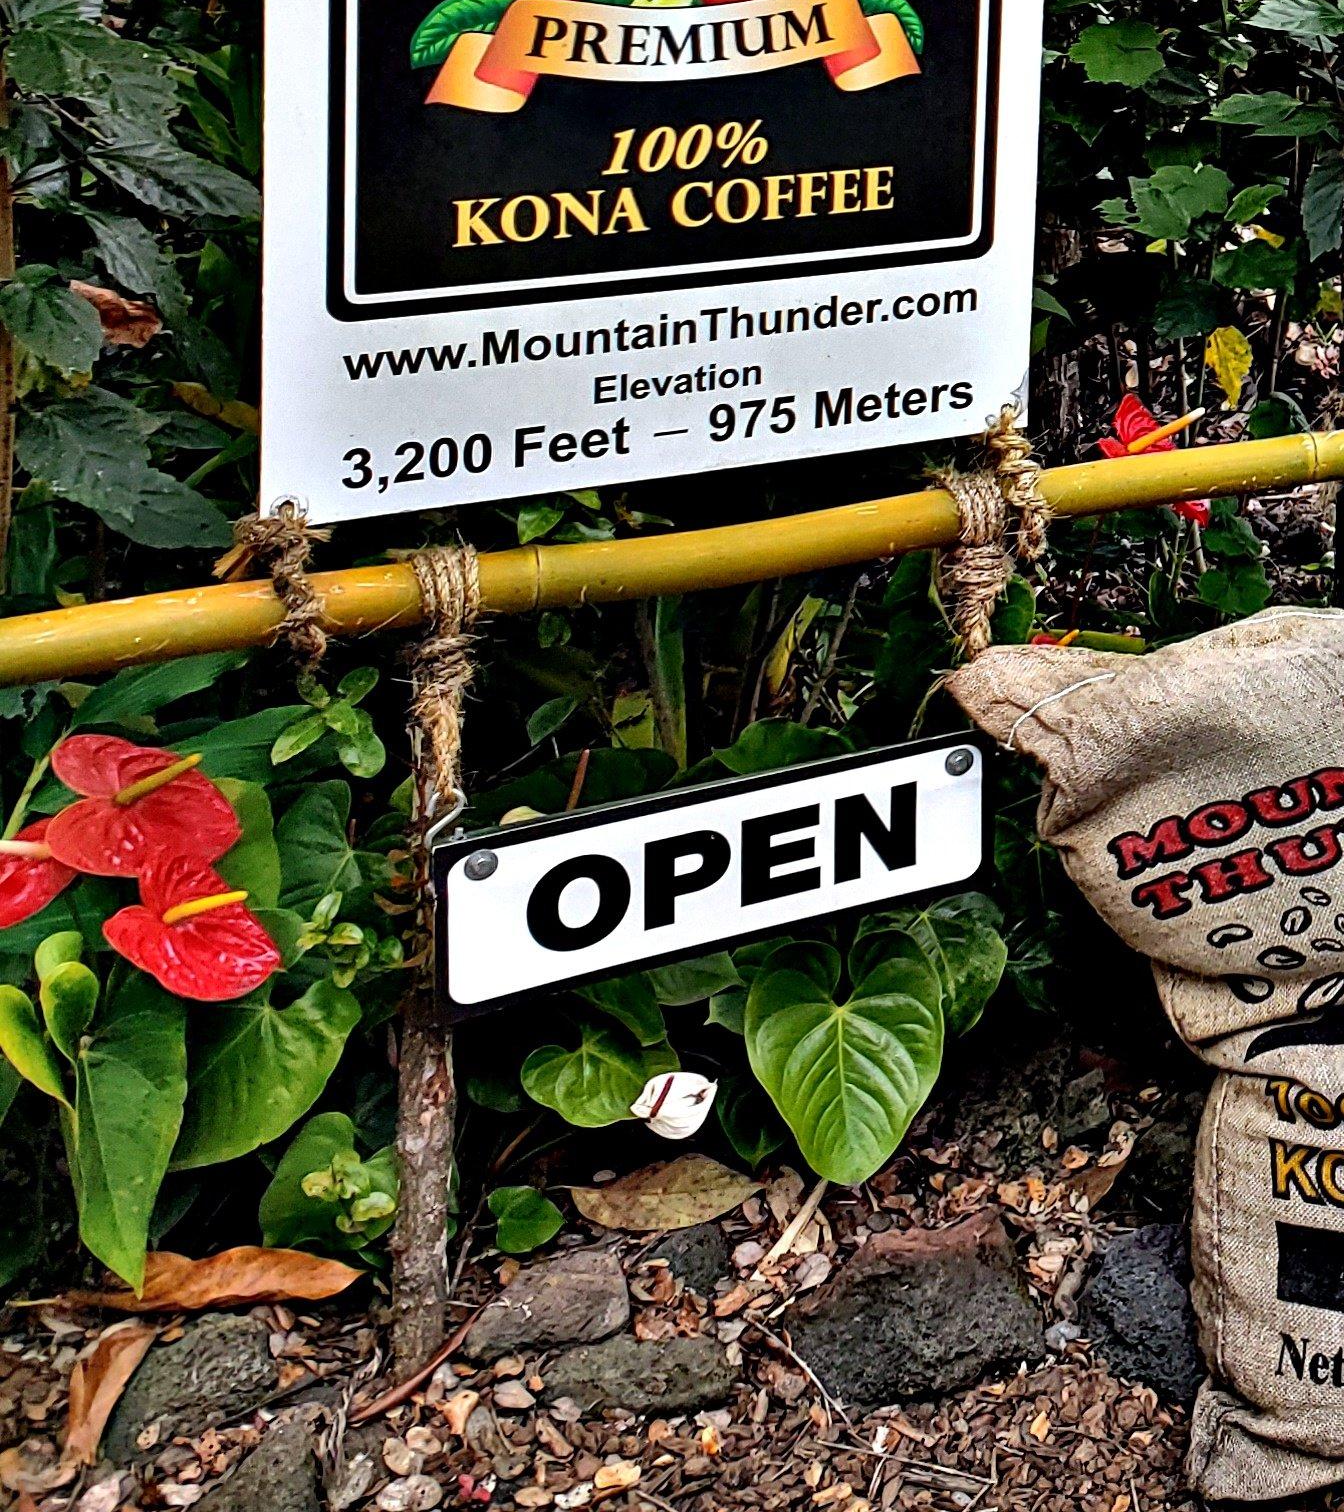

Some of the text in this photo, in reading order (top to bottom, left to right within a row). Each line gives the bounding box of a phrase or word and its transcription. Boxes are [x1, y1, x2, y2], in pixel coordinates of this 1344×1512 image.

[525, 3, 834, 66] PREMIUM
[602, 119, 768, 176] 100%
[452, 166, 895, 248] KONA COFFEE
[343, 288, 978, 381] www.MountainThunder.com
[593, 362, 763, 405] Elevation
[341, 432, 493, 492] 3,200
[514, 417, 631, 469] Feet
[708, 395, 798, 443] 975
[814, 381, 974, 430] Meters
[526, 781, 918, 953] OPEN
